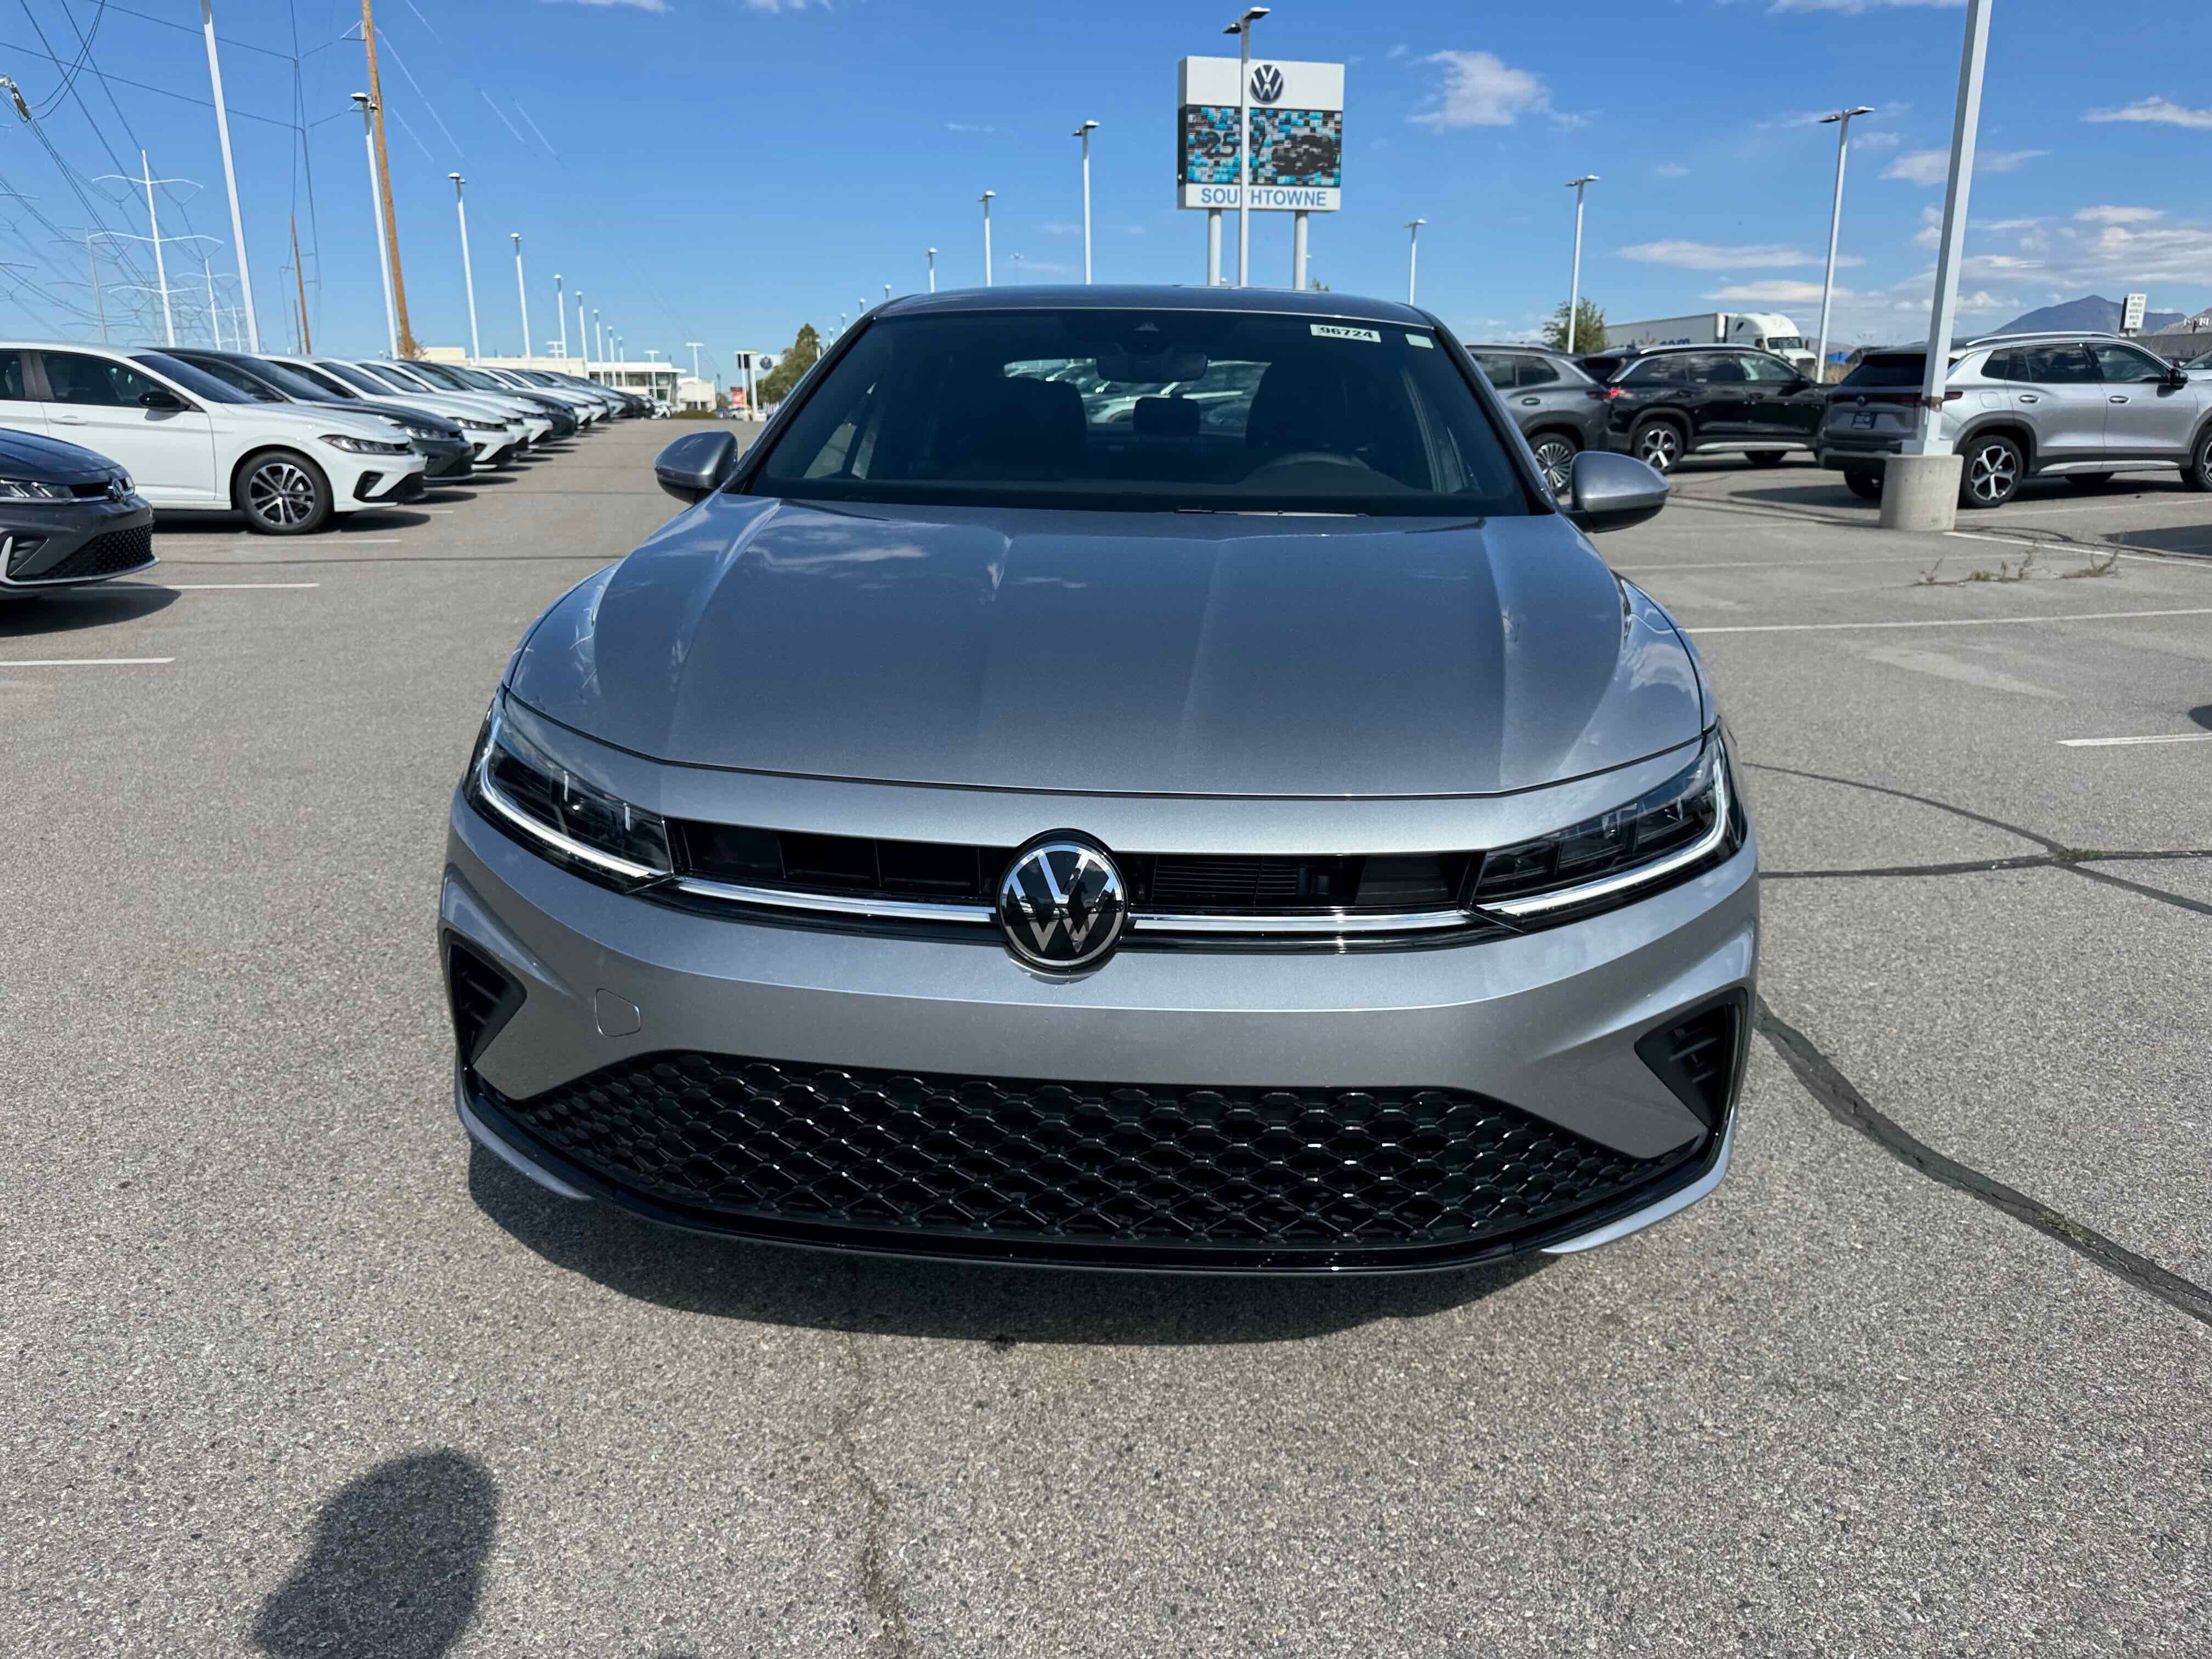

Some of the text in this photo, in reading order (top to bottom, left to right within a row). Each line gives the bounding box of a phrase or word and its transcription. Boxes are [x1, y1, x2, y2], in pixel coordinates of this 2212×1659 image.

[1250, 64, 1284, 104] VW
[1201, 188, 1327, 206] SOUHTOWNE
[1320, 327, 1373, 338] 96724
[1001, 845, 1124, 964] VW
